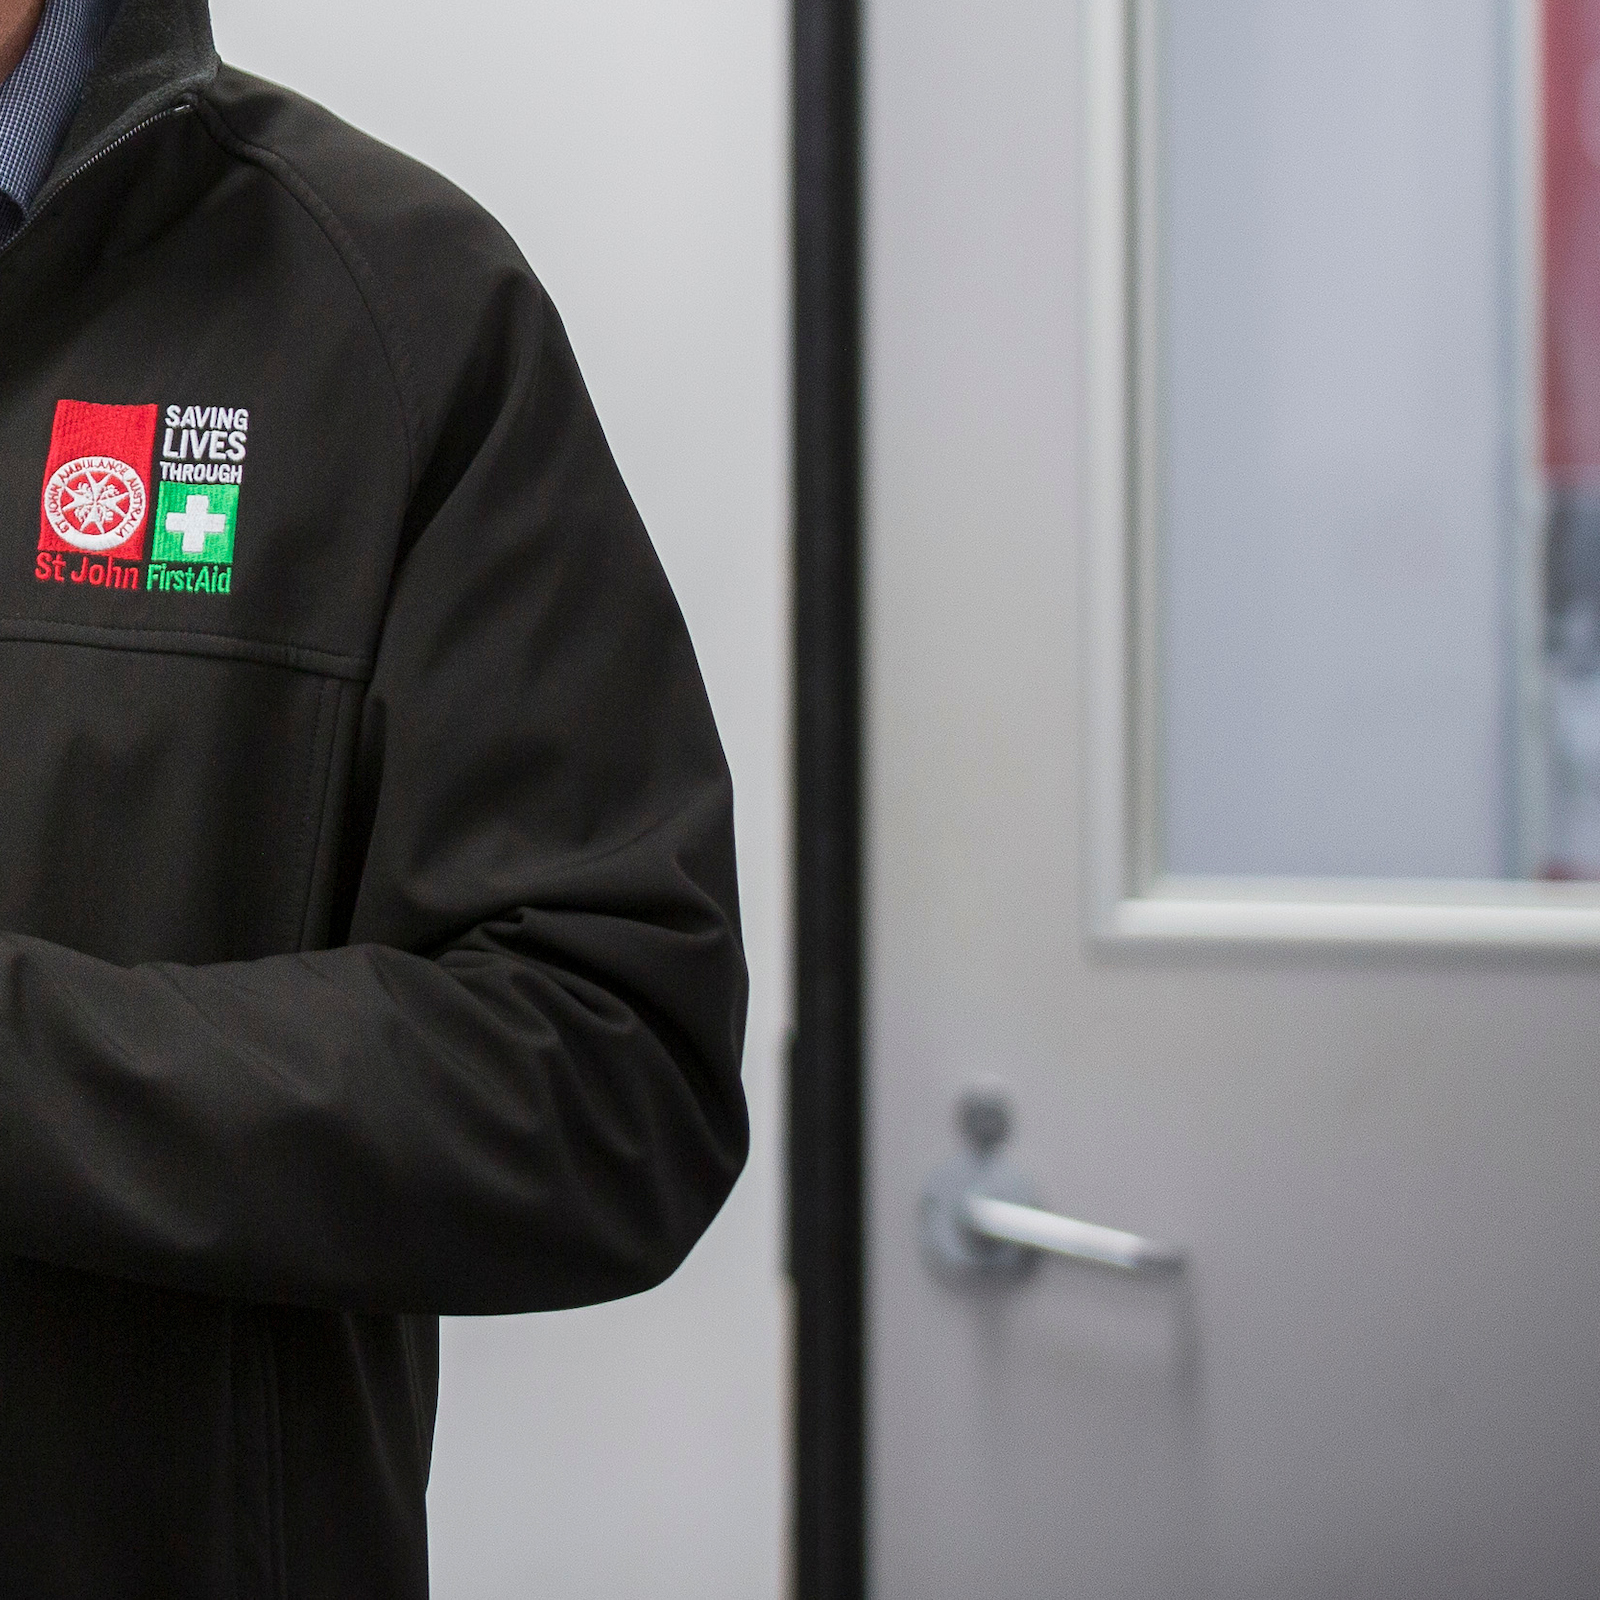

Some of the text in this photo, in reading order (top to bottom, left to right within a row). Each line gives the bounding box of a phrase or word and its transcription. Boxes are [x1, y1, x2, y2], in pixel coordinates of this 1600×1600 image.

[164, 404, 249, 431] SAVING
[162, 428, 248, 461] LIVES
[159, 460, 243, 484] THROUGH
[57, 459, 130, 484] AMBULANCE
[115, 477, 143, 538] AUSTRALIA
[34, 551, 140, 590] St John
